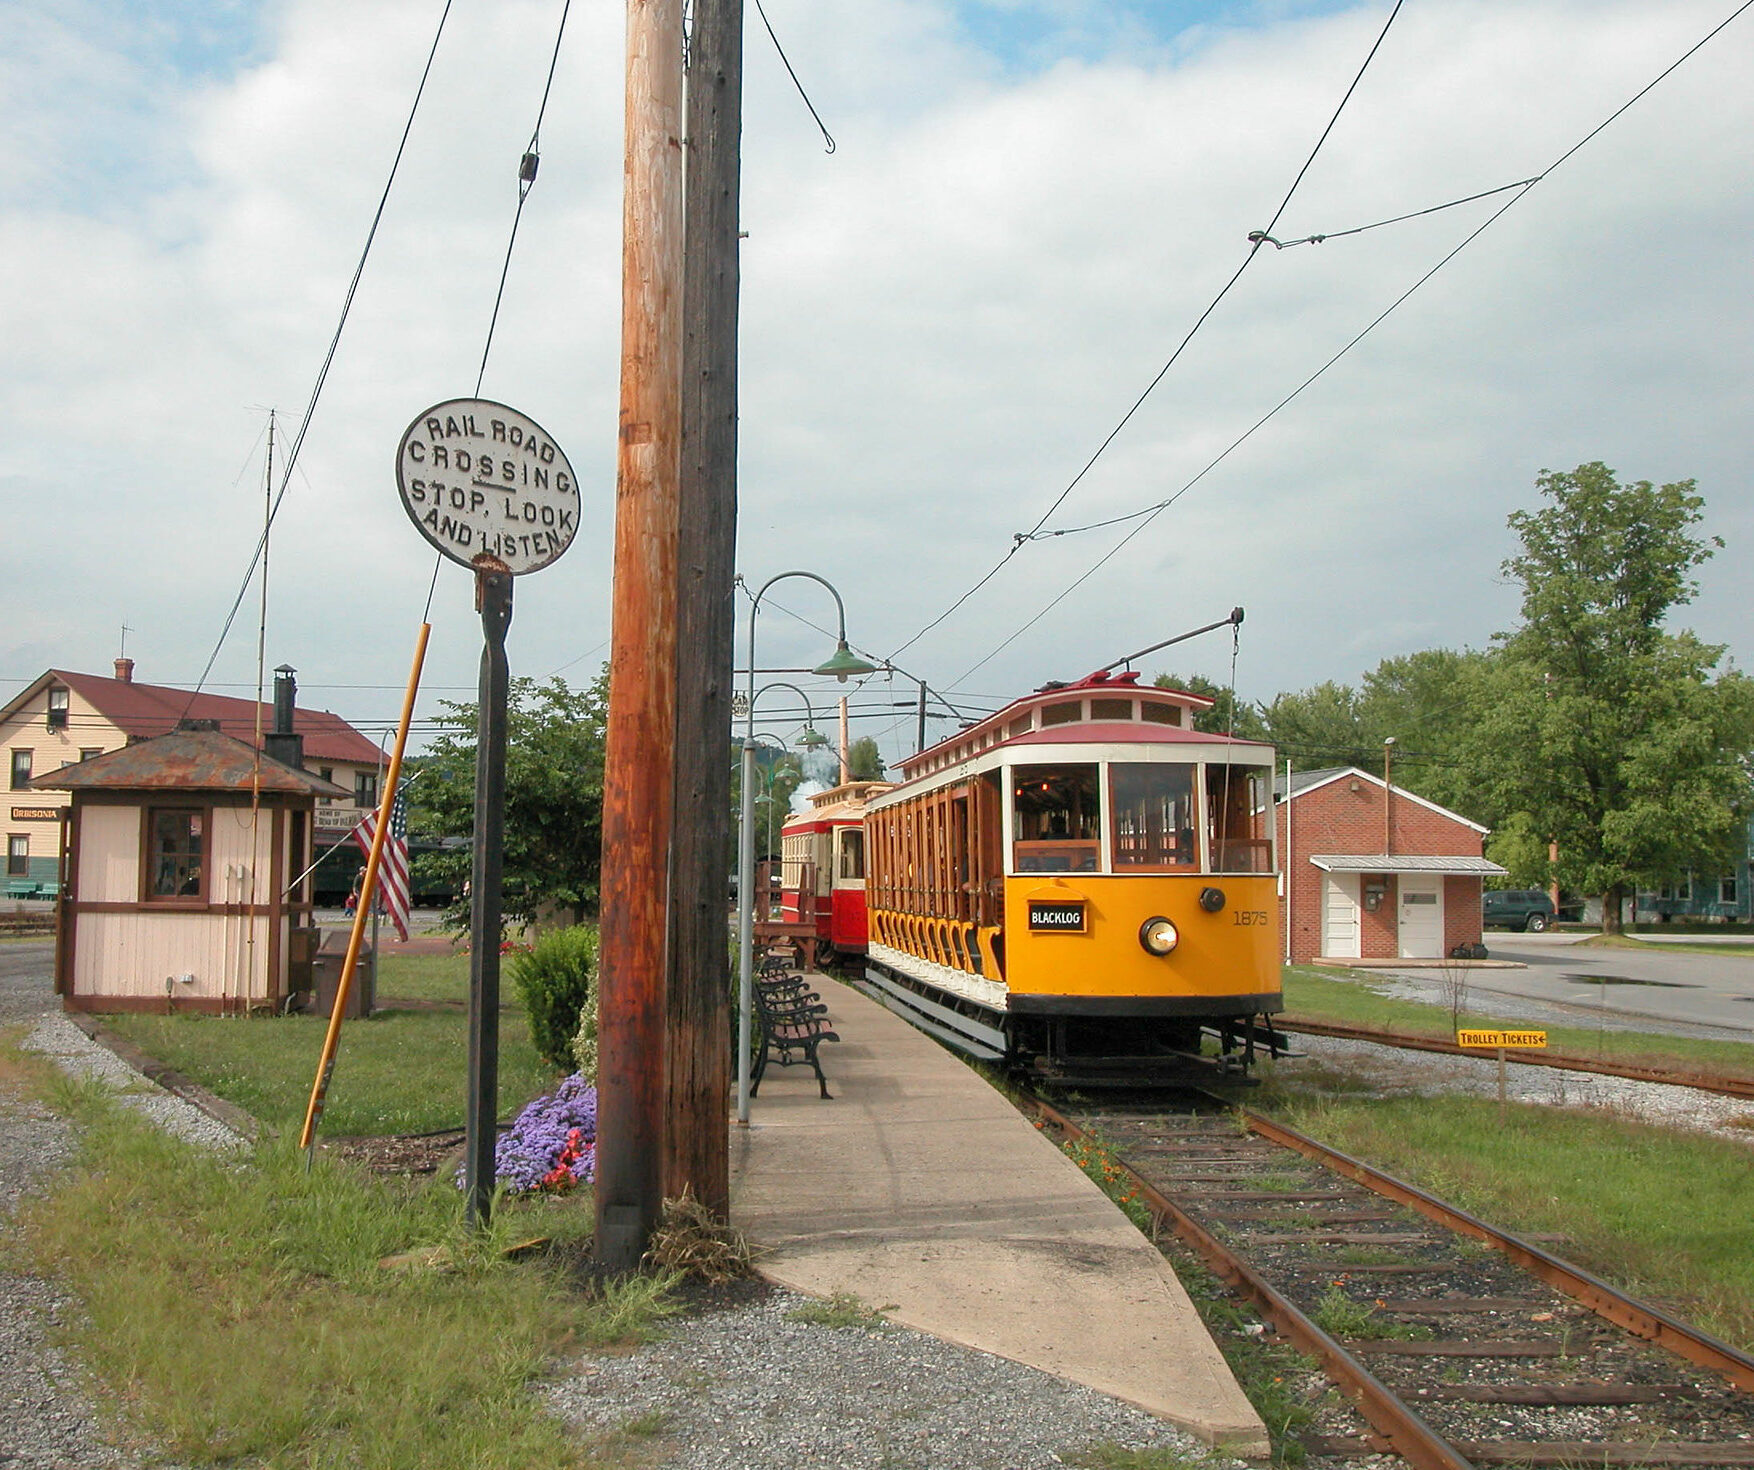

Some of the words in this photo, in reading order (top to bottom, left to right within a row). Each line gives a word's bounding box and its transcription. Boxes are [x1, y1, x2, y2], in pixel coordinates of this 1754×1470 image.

[411, 478, 489, 519] STOP,
[505, 497, 573, 531] LOOK
[423, 507, 472, 547] AND
[1031, 911, 1081, 924] BLACKLOG
[1233, 911, 1268, 926] 1875
[1460, 1033, 1498, 1044] TROLLEY
[1501, 1033, 1539, 1044] TICKETS
